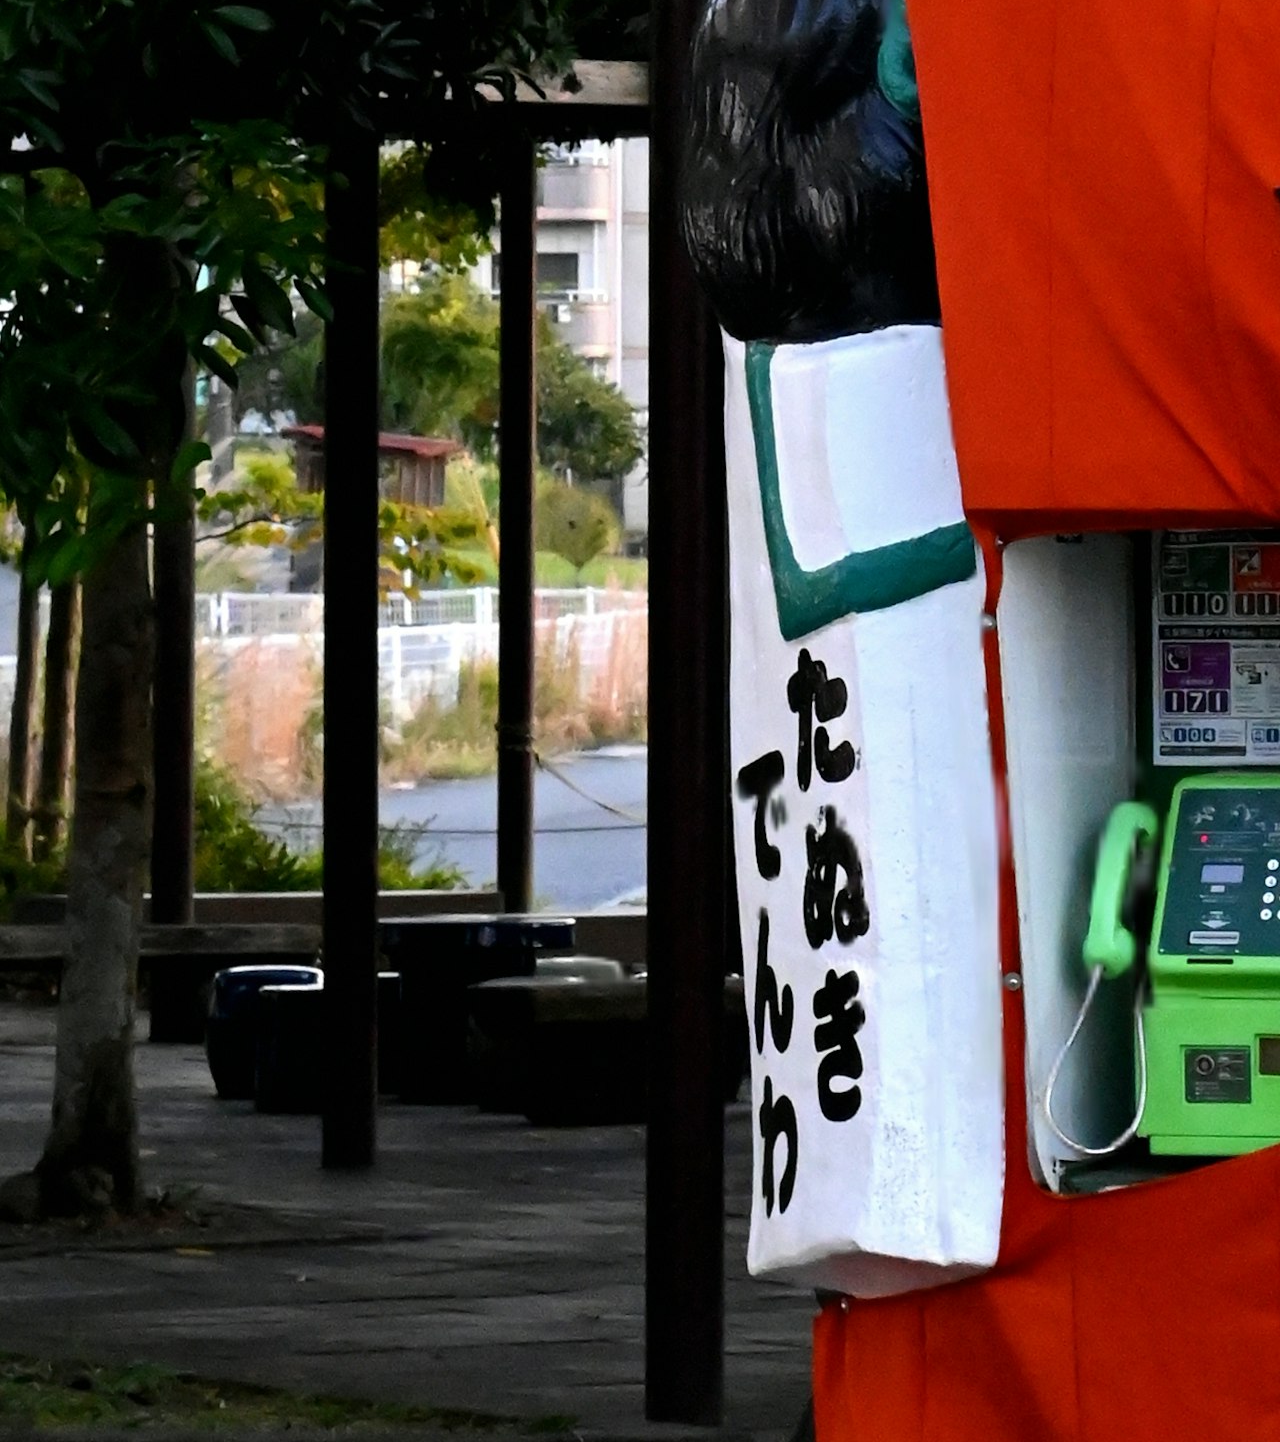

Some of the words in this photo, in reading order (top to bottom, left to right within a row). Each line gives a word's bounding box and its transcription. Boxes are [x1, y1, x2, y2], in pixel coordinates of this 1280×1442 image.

[1171, 594, 1225, 615] 110
[1171, 691, 1222, 712] 171
[737, 750, 798, 1219] でんわ
[787, 648, 869, 1123] たぬき
